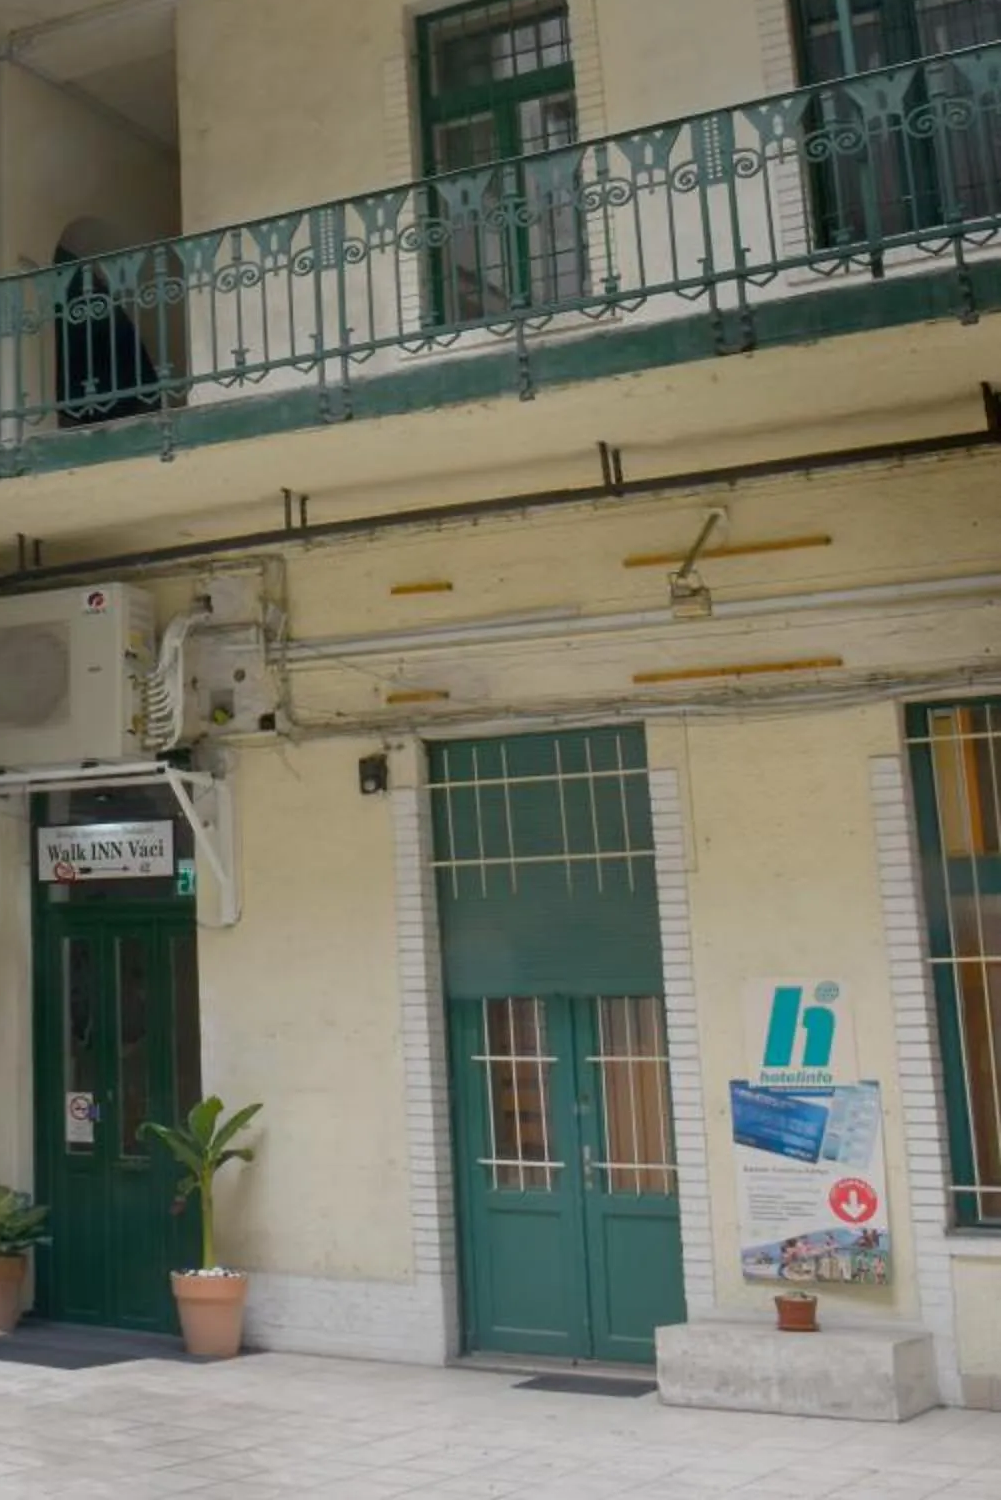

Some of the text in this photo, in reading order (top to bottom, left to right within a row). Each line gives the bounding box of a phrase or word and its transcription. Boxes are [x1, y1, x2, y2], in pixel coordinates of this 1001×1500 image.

[48, 843, 86, 862] Walk
[91, 840, 124, 861] INN
[760, 1069, 832, 1085] hotelinfo
